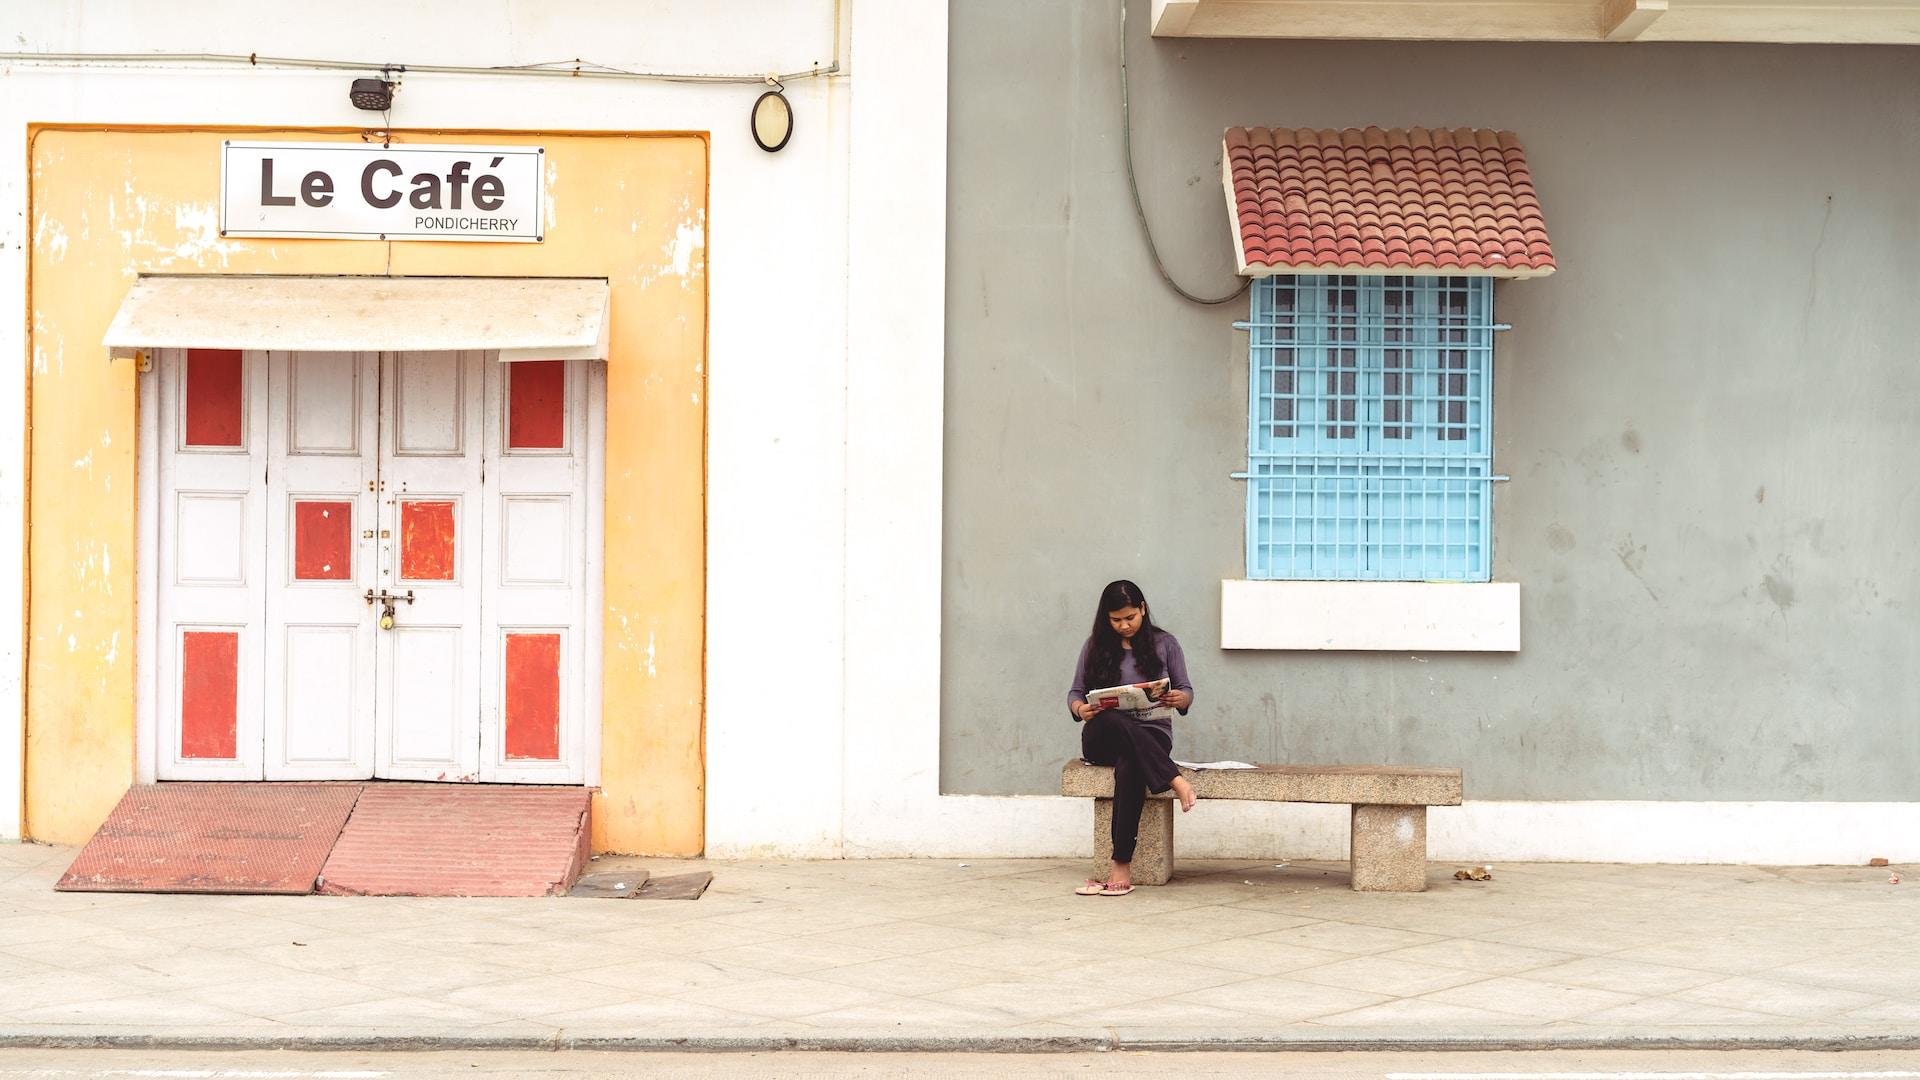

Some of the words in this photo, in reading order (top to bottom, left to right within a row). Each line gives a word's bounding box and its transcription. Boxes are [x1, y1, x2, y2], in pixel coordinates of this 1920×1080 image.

[261, 158, 334, 208] Le
[361, 157, 505, 211] Café
[415, 217, 518, 231] PONDICHERRY
